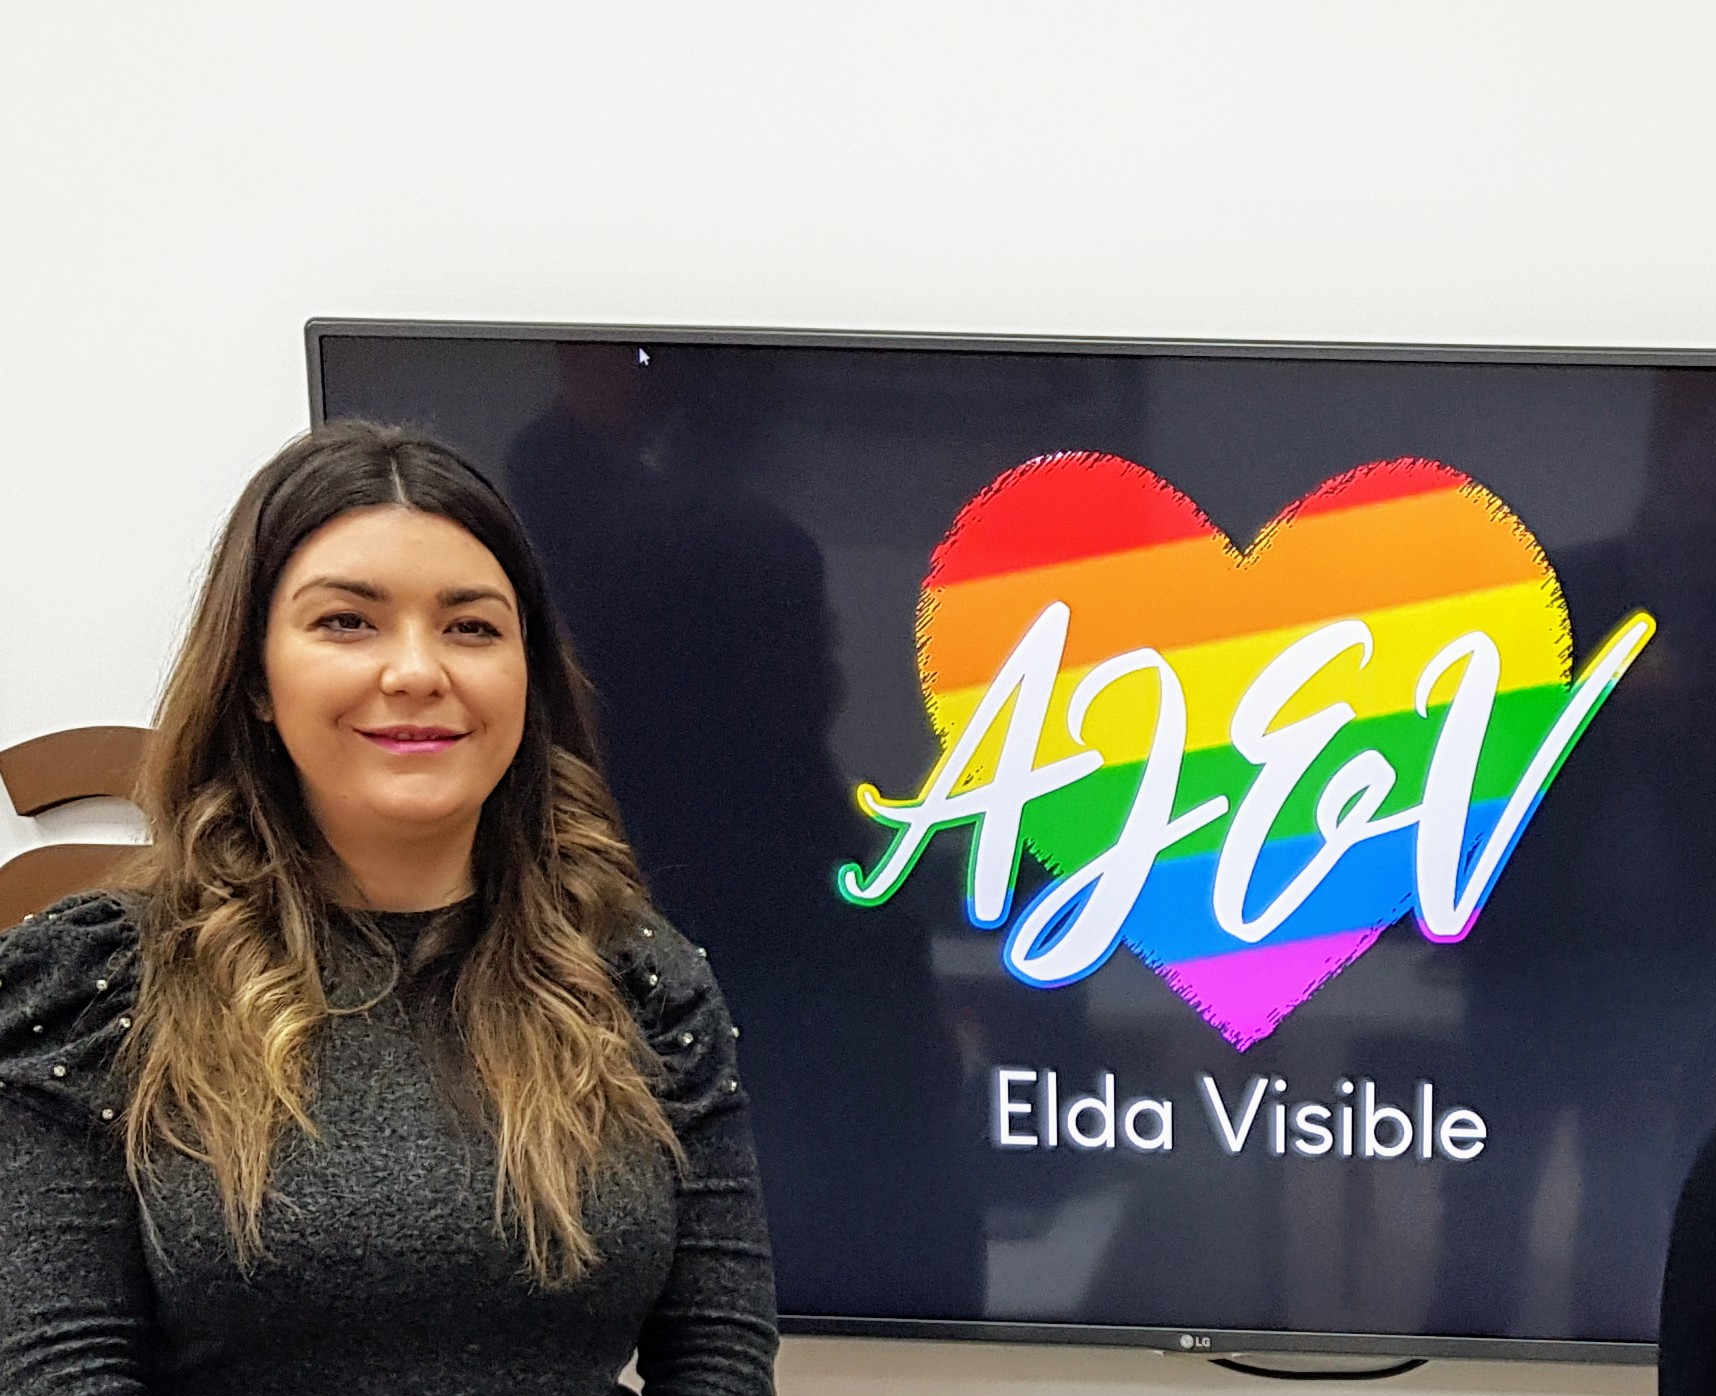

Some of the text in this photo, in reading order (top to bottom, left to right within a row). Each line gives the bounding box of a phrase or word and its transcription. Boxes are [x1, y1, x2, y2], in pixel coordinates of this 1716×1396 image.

[838, 600, 1656, 986] AJEV
[997, 1068, 1488, 1161] Elda Visible
[1195, 1336, 1211, 1348] LG
